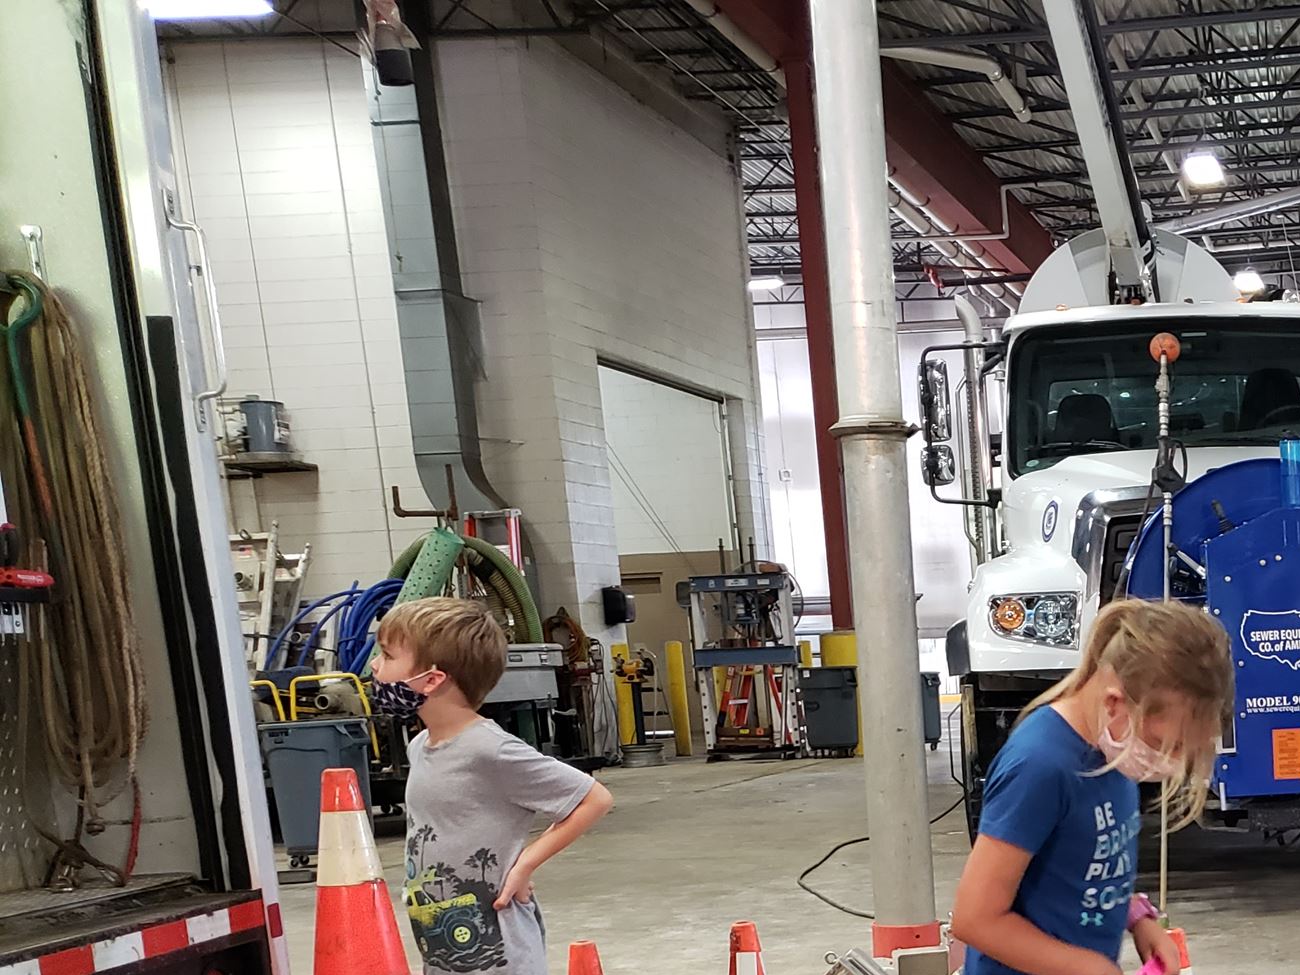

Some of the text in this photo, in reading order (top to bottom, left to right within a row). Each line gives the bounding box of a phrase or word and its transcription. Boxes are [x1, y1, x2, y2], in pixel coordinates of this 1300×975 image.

[1250, 630, 1279, 641] SEWER
[1259, 642, 1273, 652] CO.
[1274, 641, 1284, 651] of
[1246, 696, 1290, 708] MODEL
[1094, 801, 1116, 831] BE
